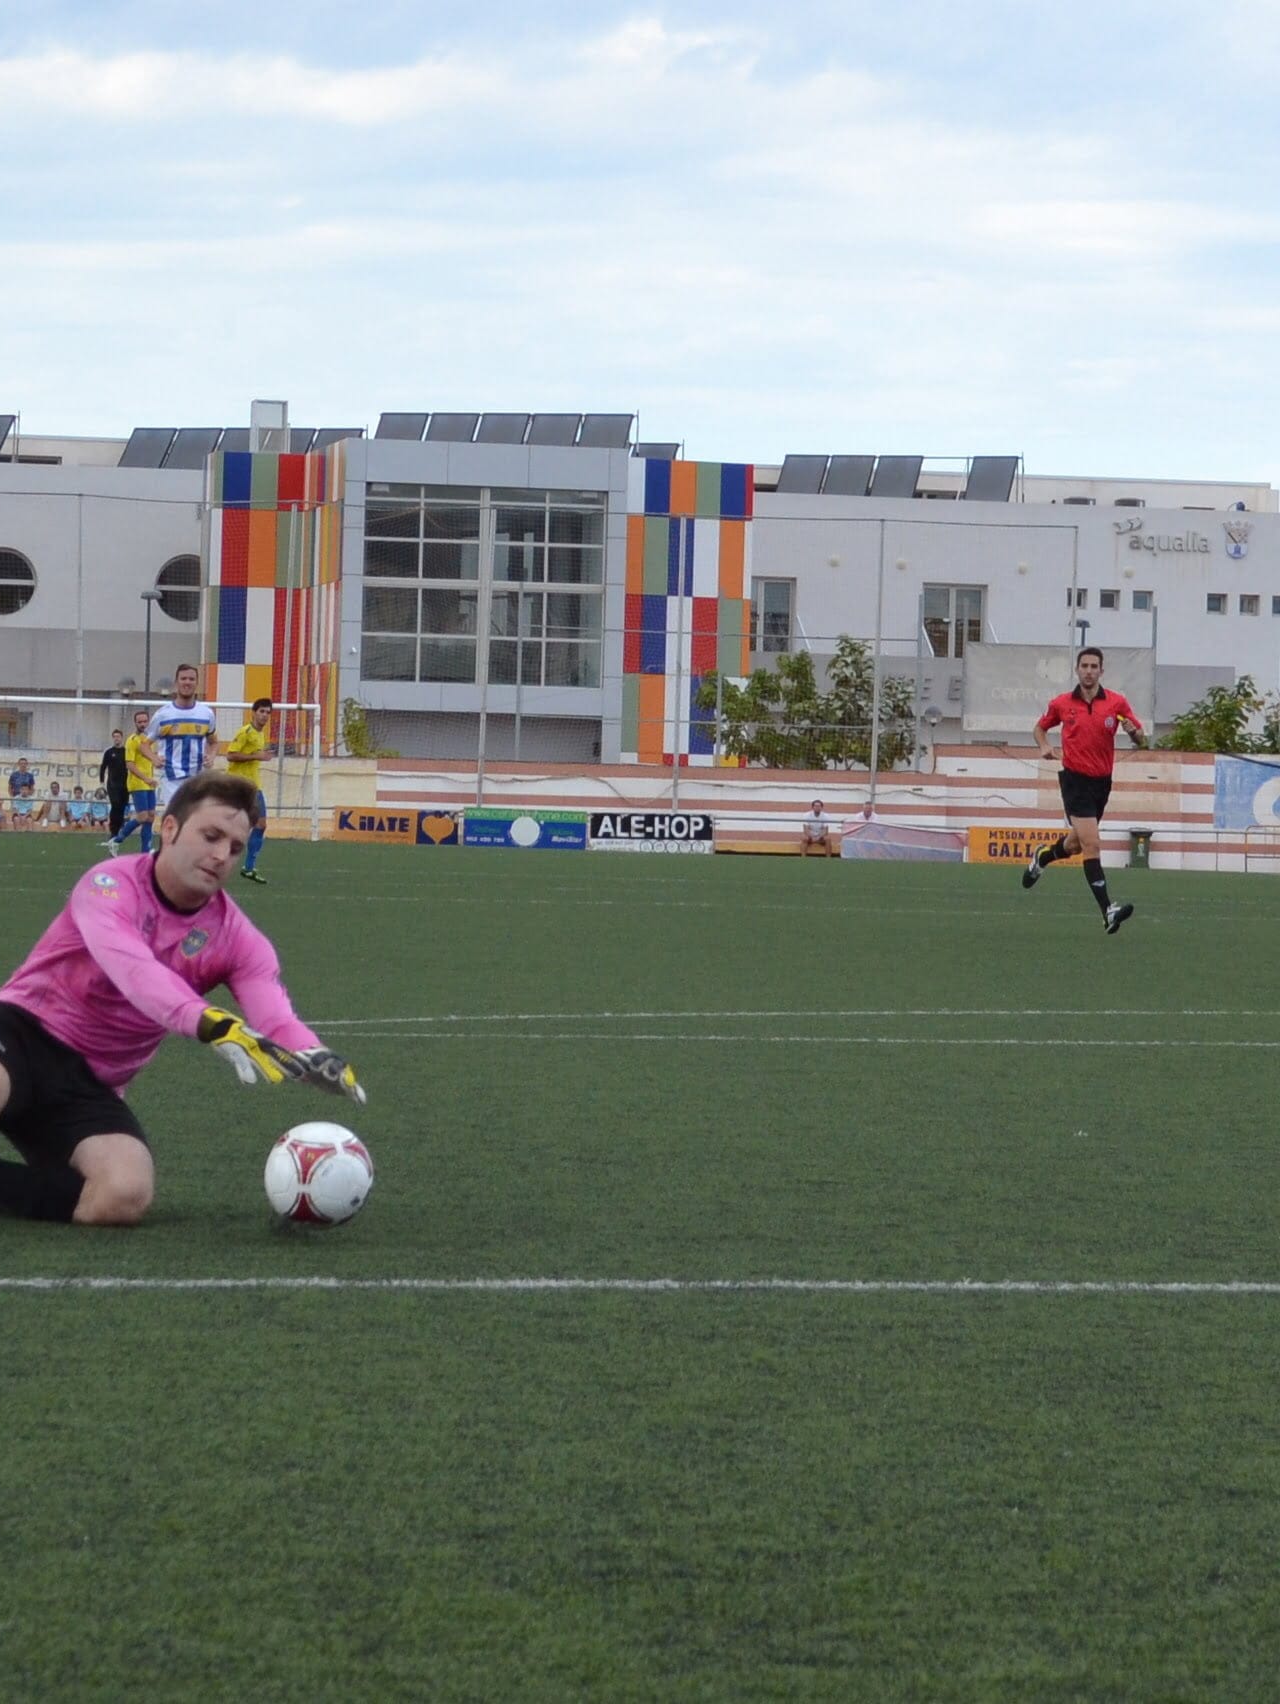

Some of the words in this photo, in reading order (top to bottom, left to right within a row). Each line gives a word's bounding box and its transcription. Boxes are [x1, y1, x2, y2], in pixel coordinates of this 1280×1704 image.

[1128, 530, 1211, 557] aqualia
[598, 815, 705, 839] ALE-HOP
[988, 842, 1038, 858] GALL
